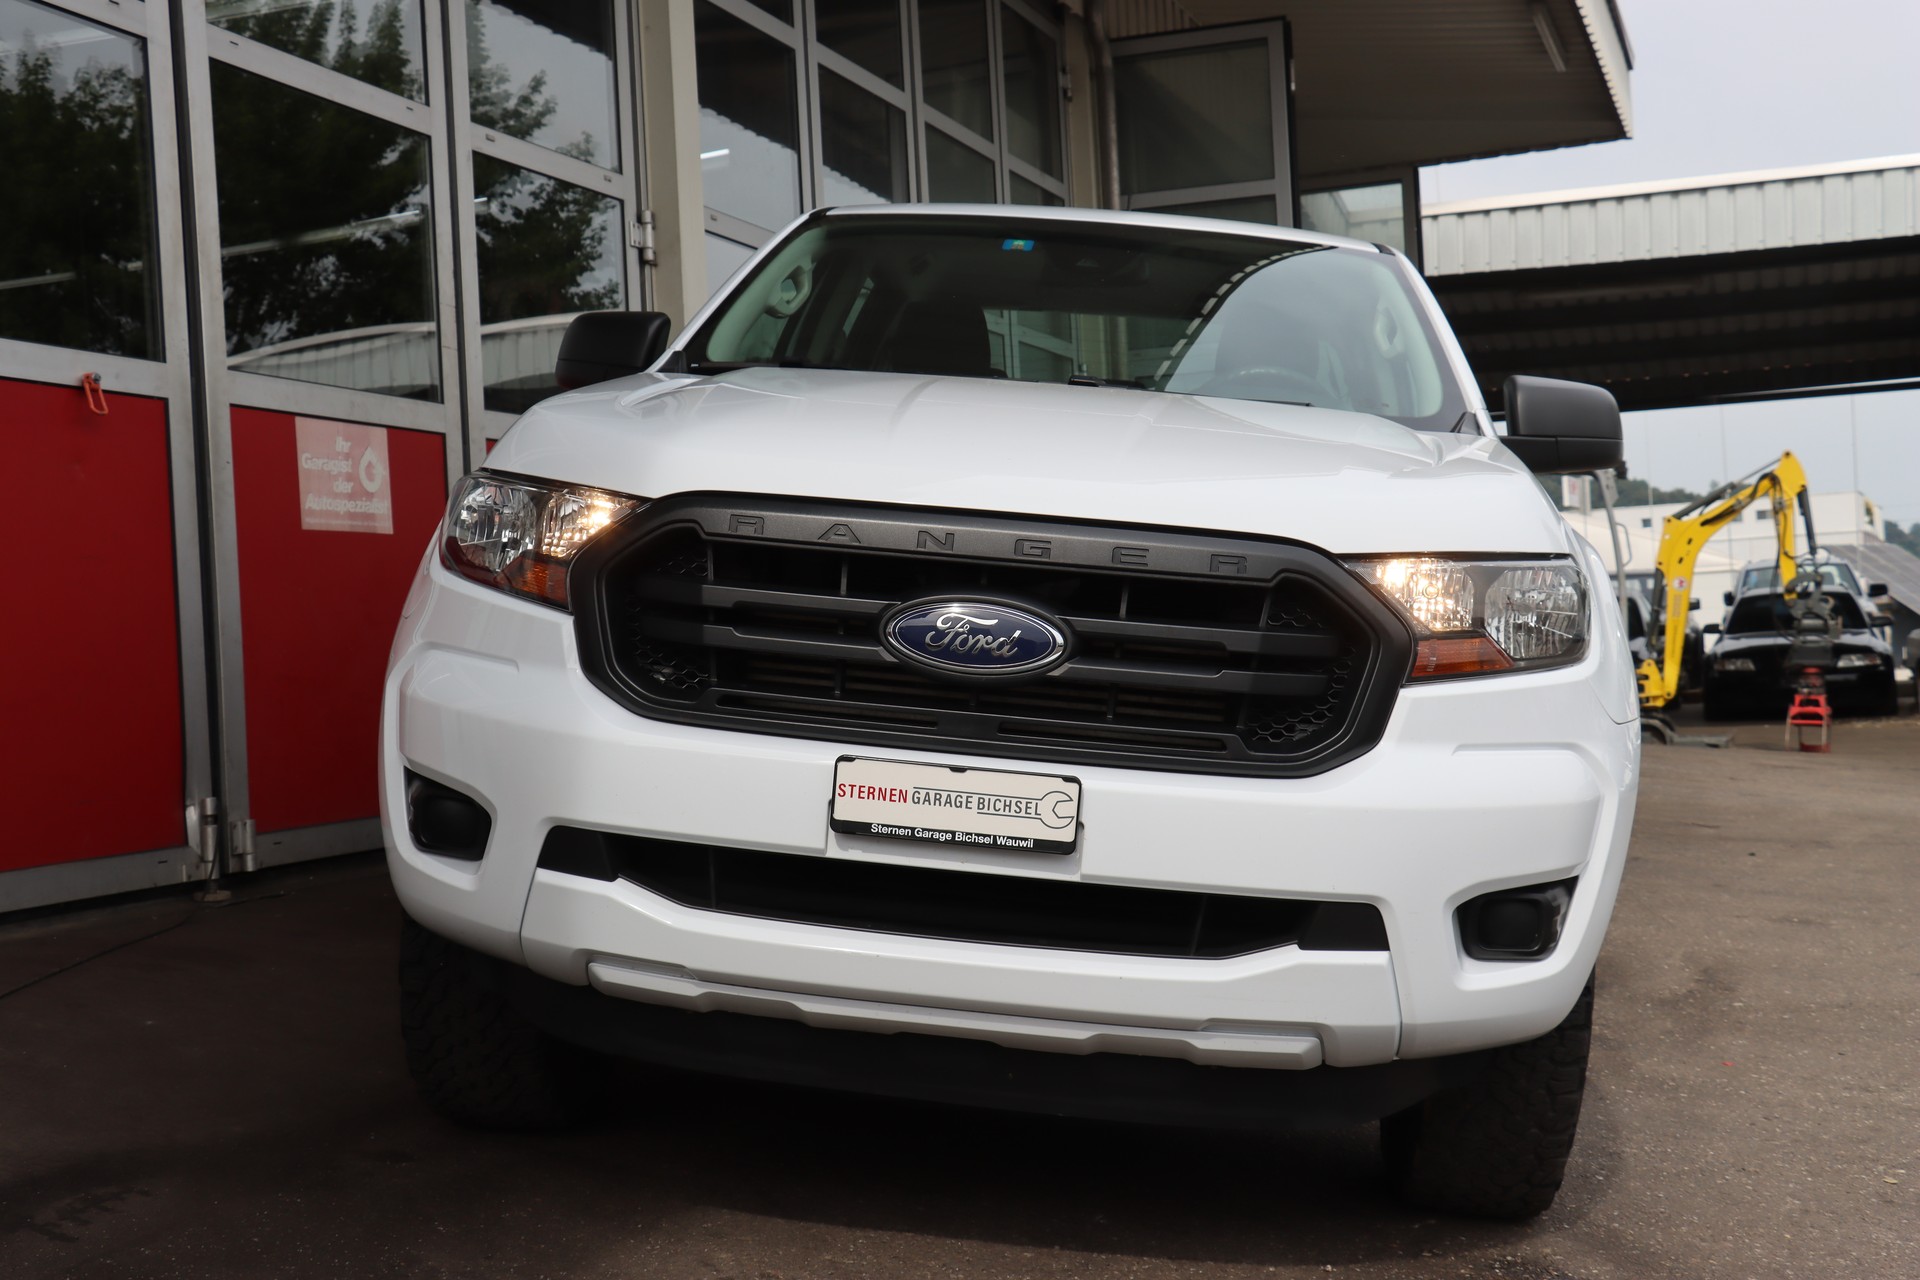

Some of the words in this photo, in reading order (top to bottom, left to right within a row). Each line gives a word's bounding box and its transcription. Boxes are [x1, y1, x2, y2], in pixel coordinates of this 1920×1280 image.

[335, 436, 352, 453] Ihr
[301, 453, 353, 475] Garagist
[333, 477, 354, 493] der
[304, 493, 388, 515] Autospezialist
[728, 513, 1248, 575] RANGER
[924, 612, 1021, 660] Ford
[837, 783, 908, 804] STERNEN
[911, 790, 973, 810] GARAGE
[976, 797, 1042, 816] BICHSEL
[870, 823, 912, 837] Sternen
[914, 828, 953, 842] Garage
[955, 831, 993, 845] Bichsel
[996, 836, 1034, 848] Wauwil
